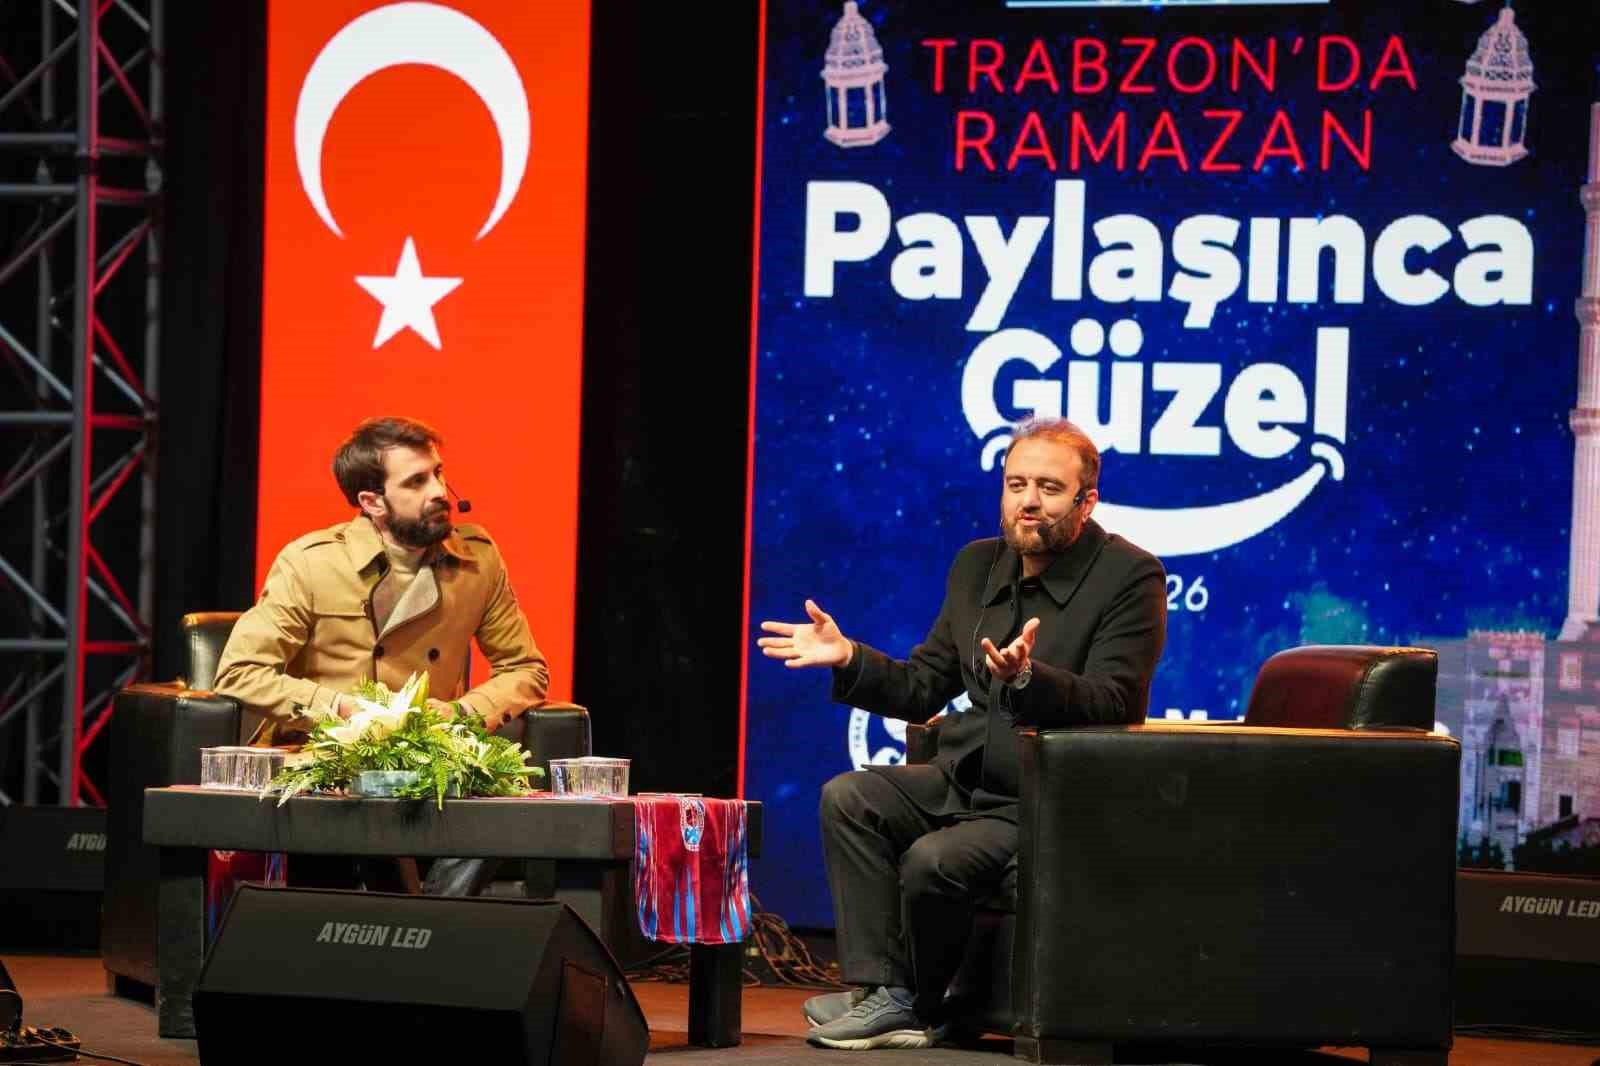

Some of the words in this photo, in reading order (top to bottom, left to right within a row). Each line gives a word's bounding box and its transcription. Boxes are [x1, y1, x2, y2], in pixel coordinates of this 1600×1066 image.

[954, 109, 1372, 172] RAMAZAN
[803, 179, 1534, 332] Paylaşınca
[961, 318, 1349, 459] Güzel
[316, 921, 391, 946] AYGÜN
[391, 927, 433, 949] LED
[1499, 895, 1563, 915] AYGÜN
[1567, 900, 1600, 918] LED
